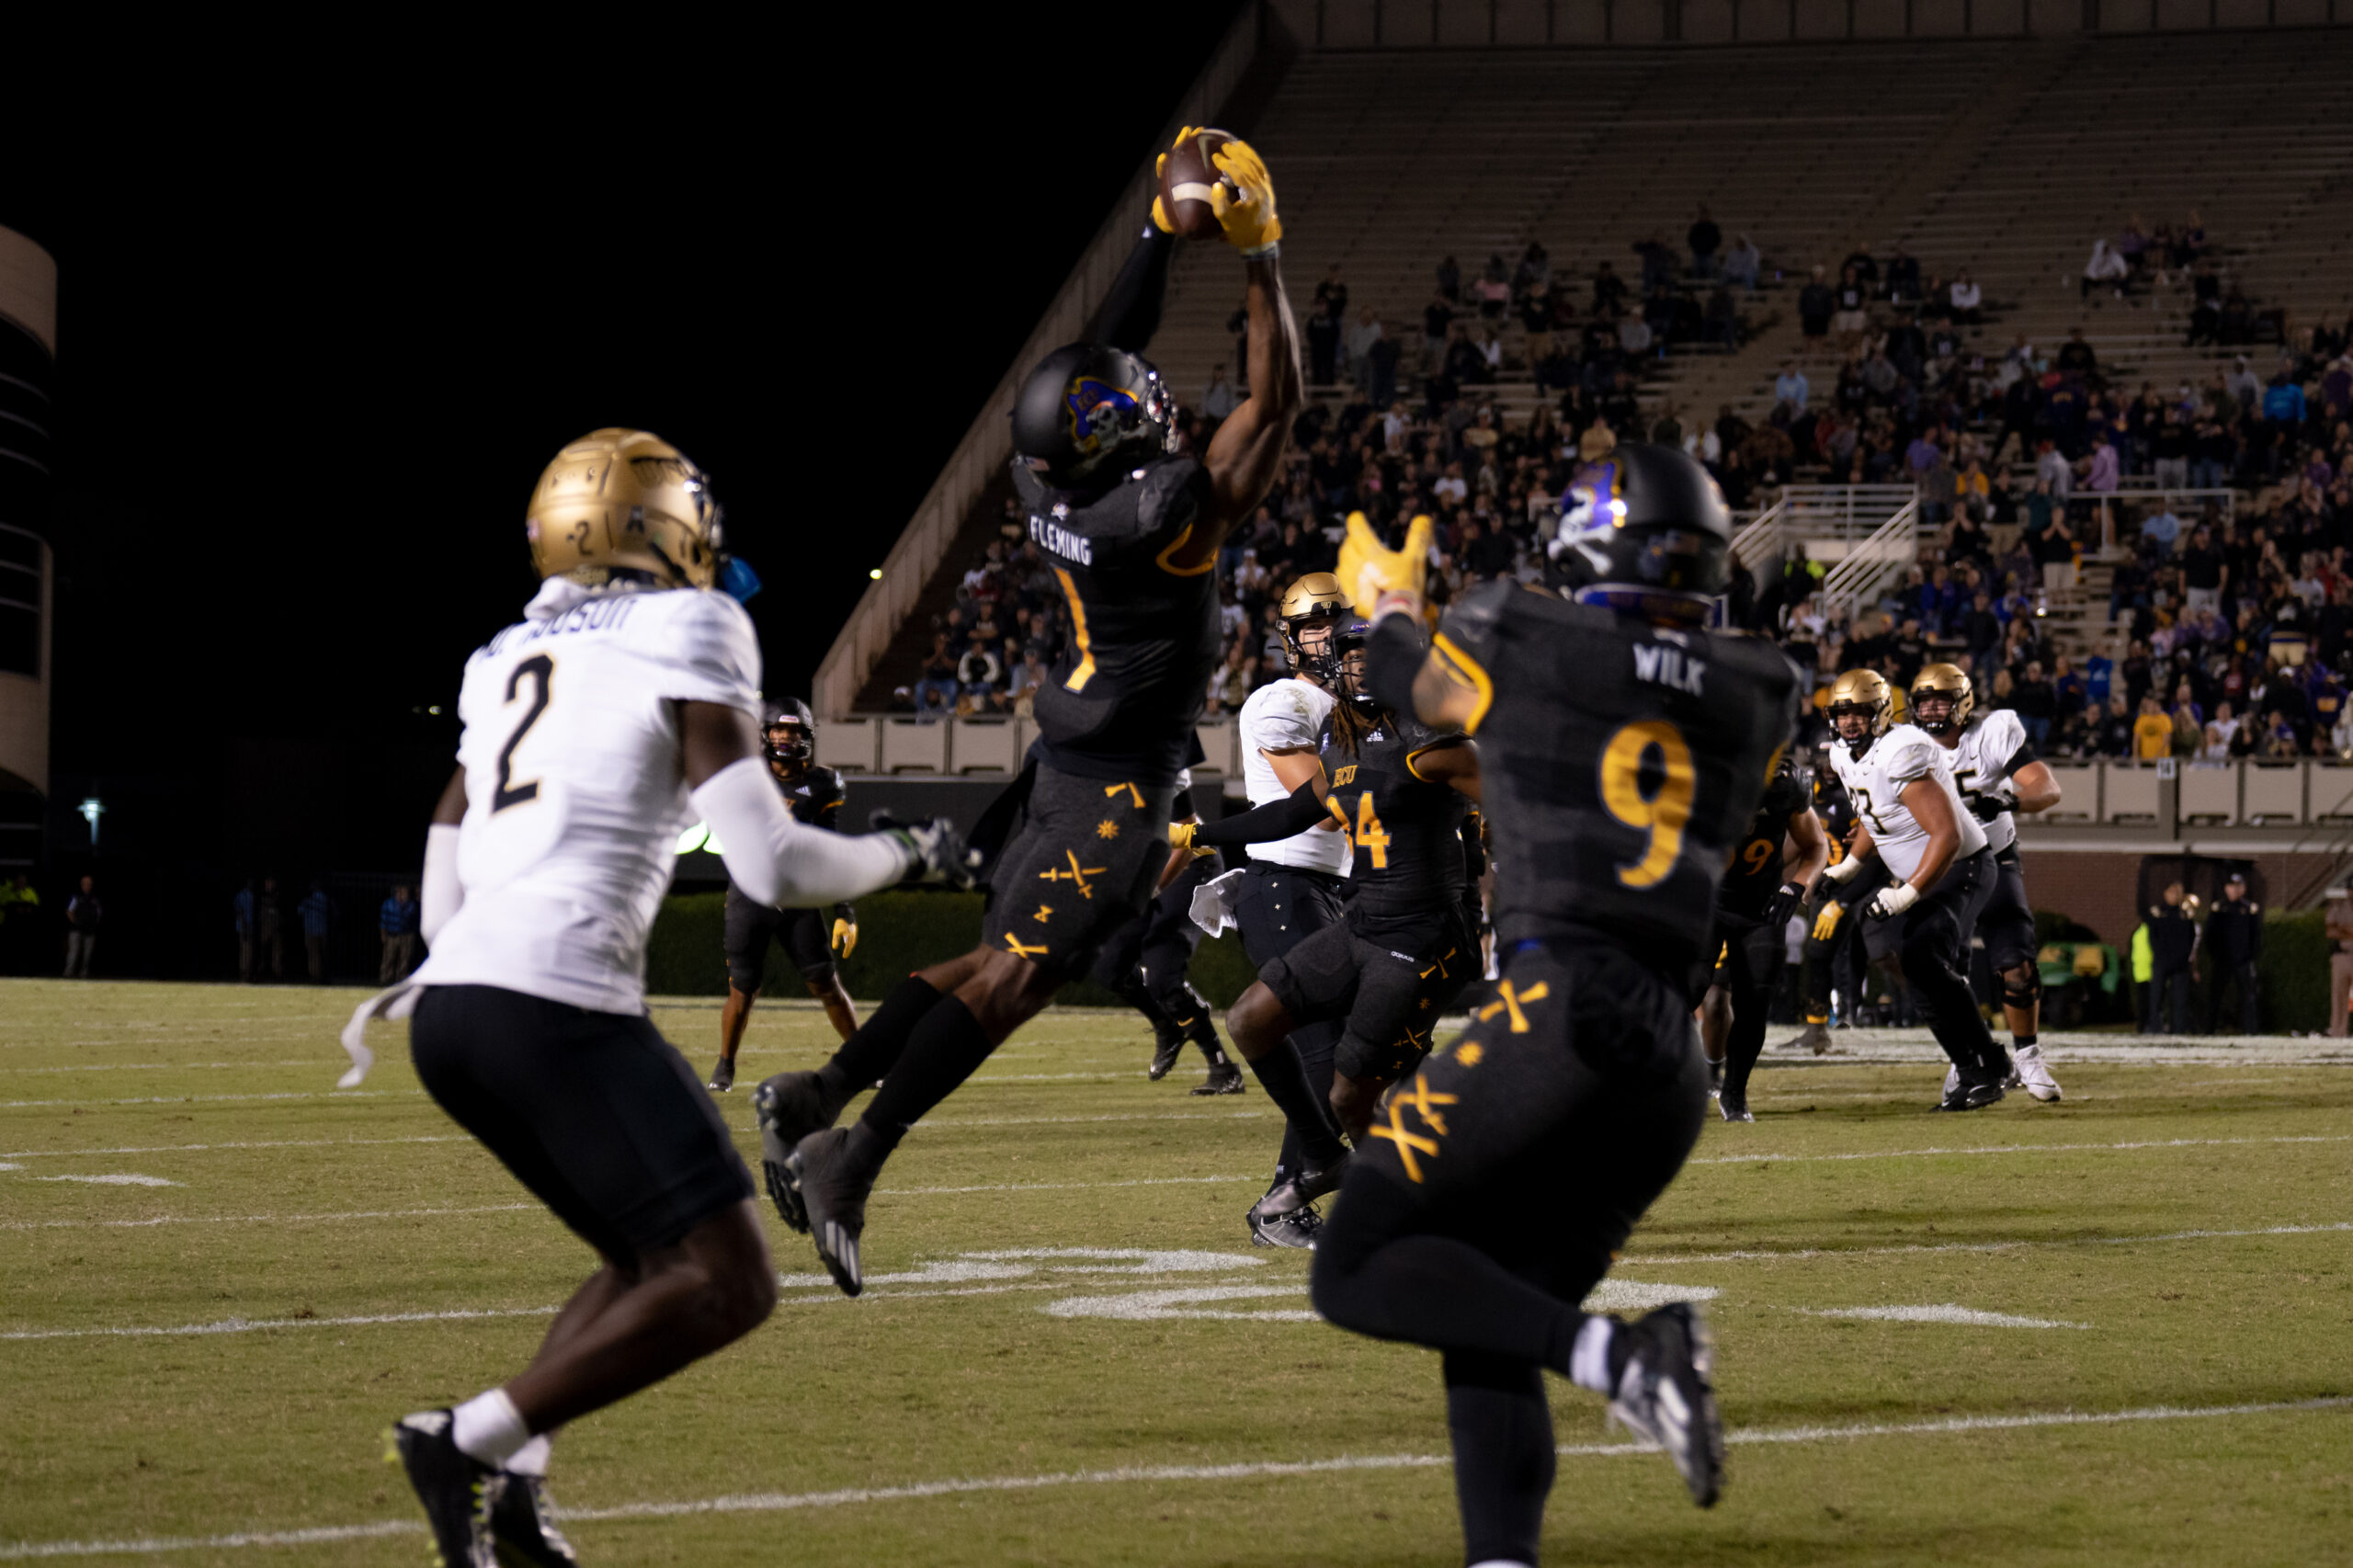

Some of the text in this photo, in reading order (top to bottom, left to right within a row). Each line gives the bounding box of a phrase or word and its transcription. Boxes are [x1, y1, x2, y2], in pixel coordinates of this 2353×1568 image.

[1030, 515, 1093, 566] FLEMING
[1051, 562, 1097, 695] 1
[1632, 642, 1707, 698] WILK
[491, 653, 556, 815] 2
[1332, 764, 1358, 789] ECU
[1597, 714, 1699, 891] 9
